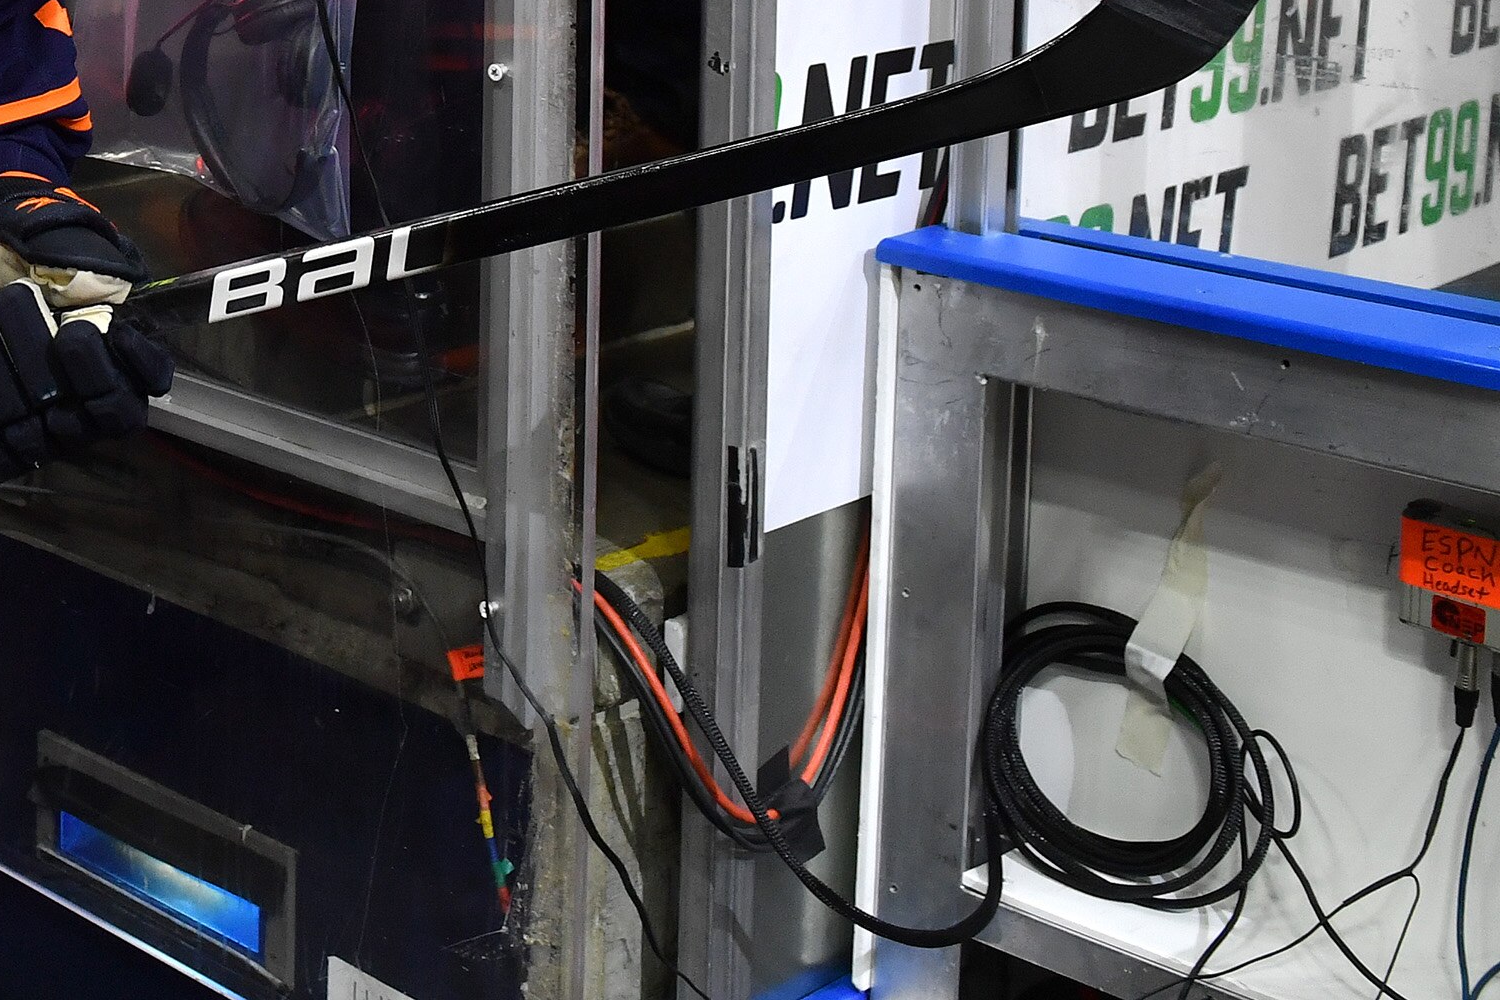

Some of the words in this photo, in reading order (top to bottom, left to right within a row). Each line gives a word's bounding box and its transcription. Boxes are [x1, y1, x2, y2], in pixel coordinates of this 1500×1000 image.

[1422, 528, 1498, 568] ESPN
[1422, 571, 1491, 600] Headset
[1423, 555, 1496, 588] Coach
